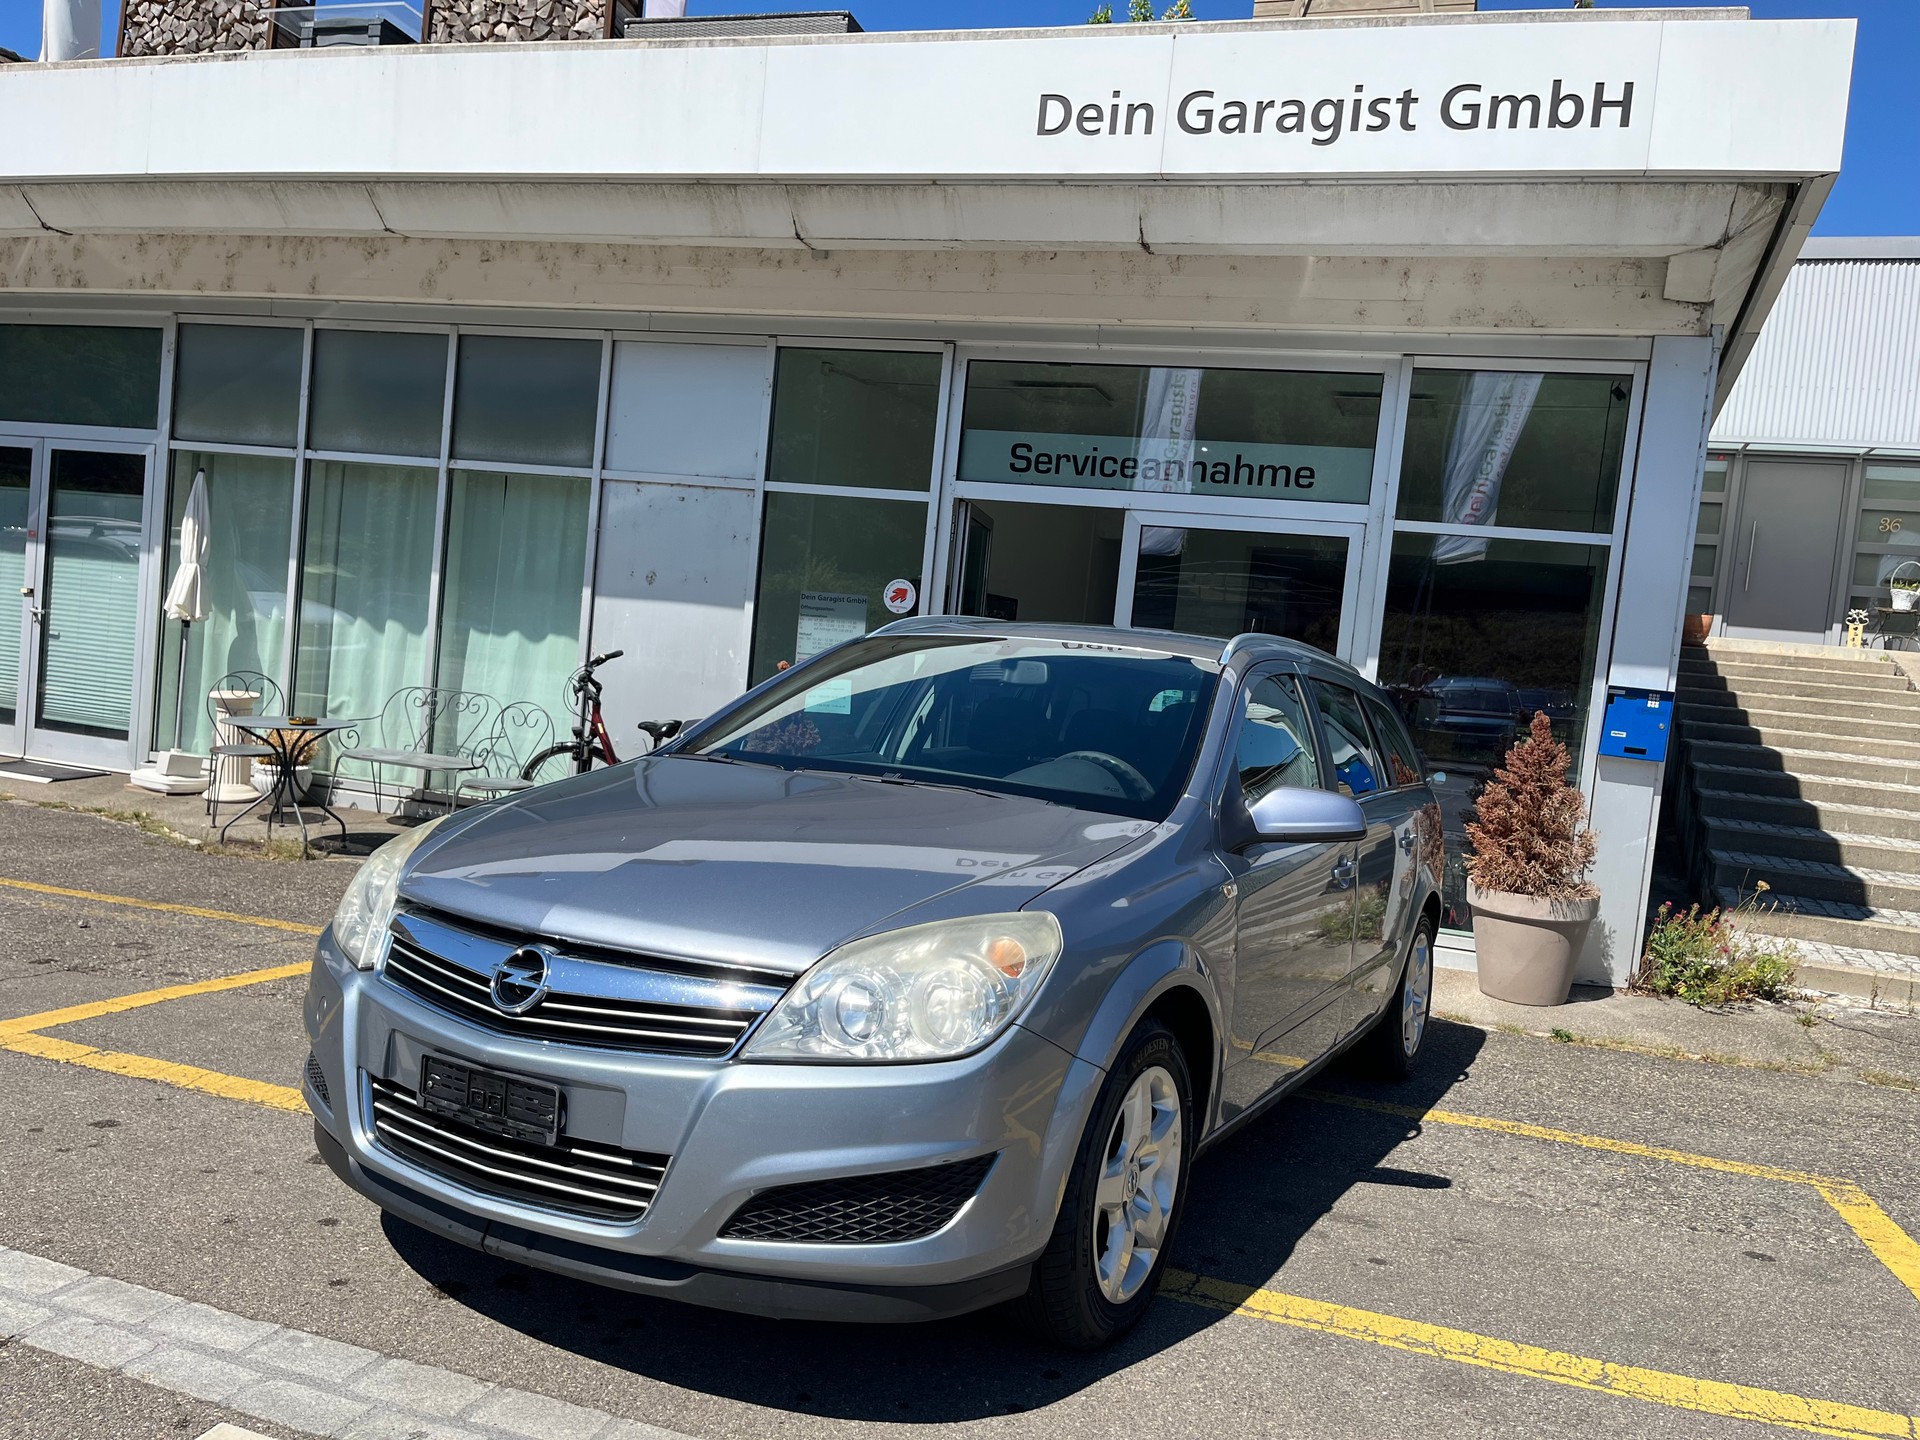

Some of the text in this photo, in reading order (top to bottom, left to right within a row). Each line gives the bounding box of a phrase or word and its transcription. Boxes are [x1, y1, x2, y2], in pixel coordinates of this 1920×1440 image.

[1036, 79, 1635, 146] Dein Garagist GmbH
[1009, 443, 1316, 489] Serviceannahme
[1879, 517, 1902, 533] 36
[801, 593, 816, 601] Dein
[818, 594, 845, 603] Garagist
